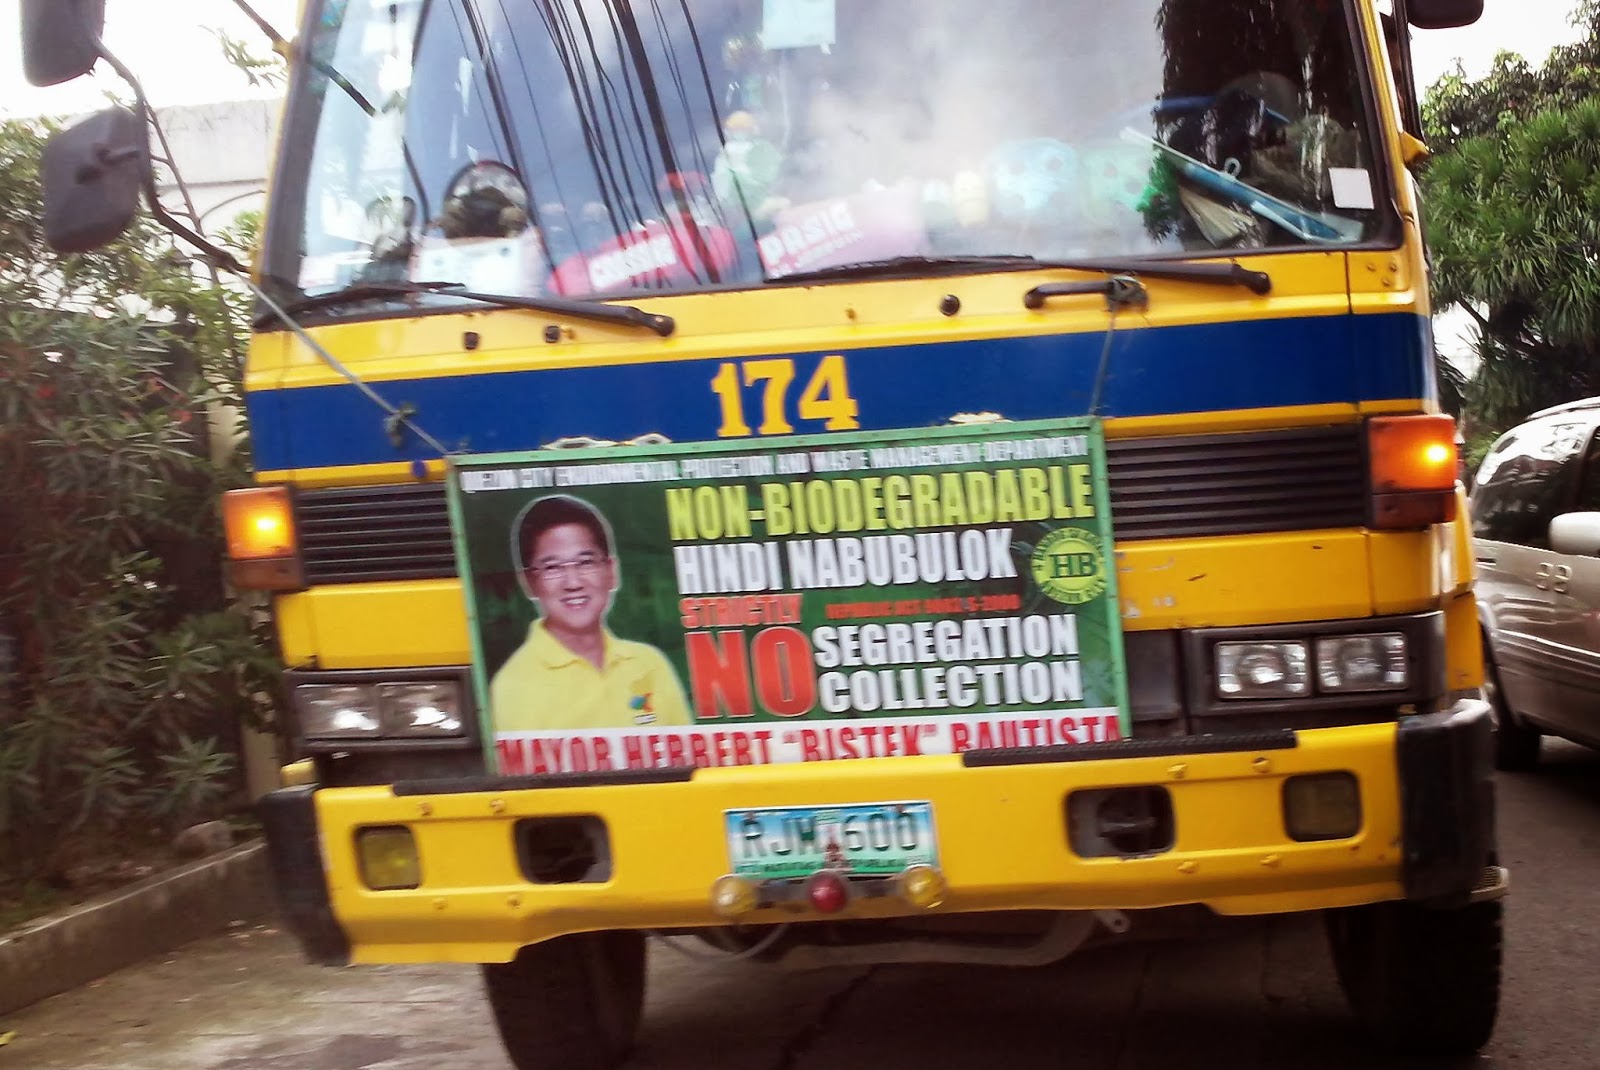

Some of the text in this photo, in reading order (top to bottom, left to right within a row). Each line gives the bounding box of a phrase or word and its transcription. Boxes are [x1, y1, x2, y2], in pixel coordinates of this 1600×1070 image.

[710, 355, 860, 438] 174
[665, 464, 1095, 541] NON-BIODEGRADABLE
[673, 541, 784, 595] HINDI
[786, 527, 1018, 590] NABUBULOK
[1048, 552, 1098, 579] HB
[679, 594, 803, 628] STRICTLY
[812, 613, 1080, 668] SEGREGATION
[684, 626, 817, 719] NO
[817, 660, 1084, 713] COLLECTION
[496, 736, 614, 776] MAYOR
[952, 715, 1122, 754] BAUTISTA
